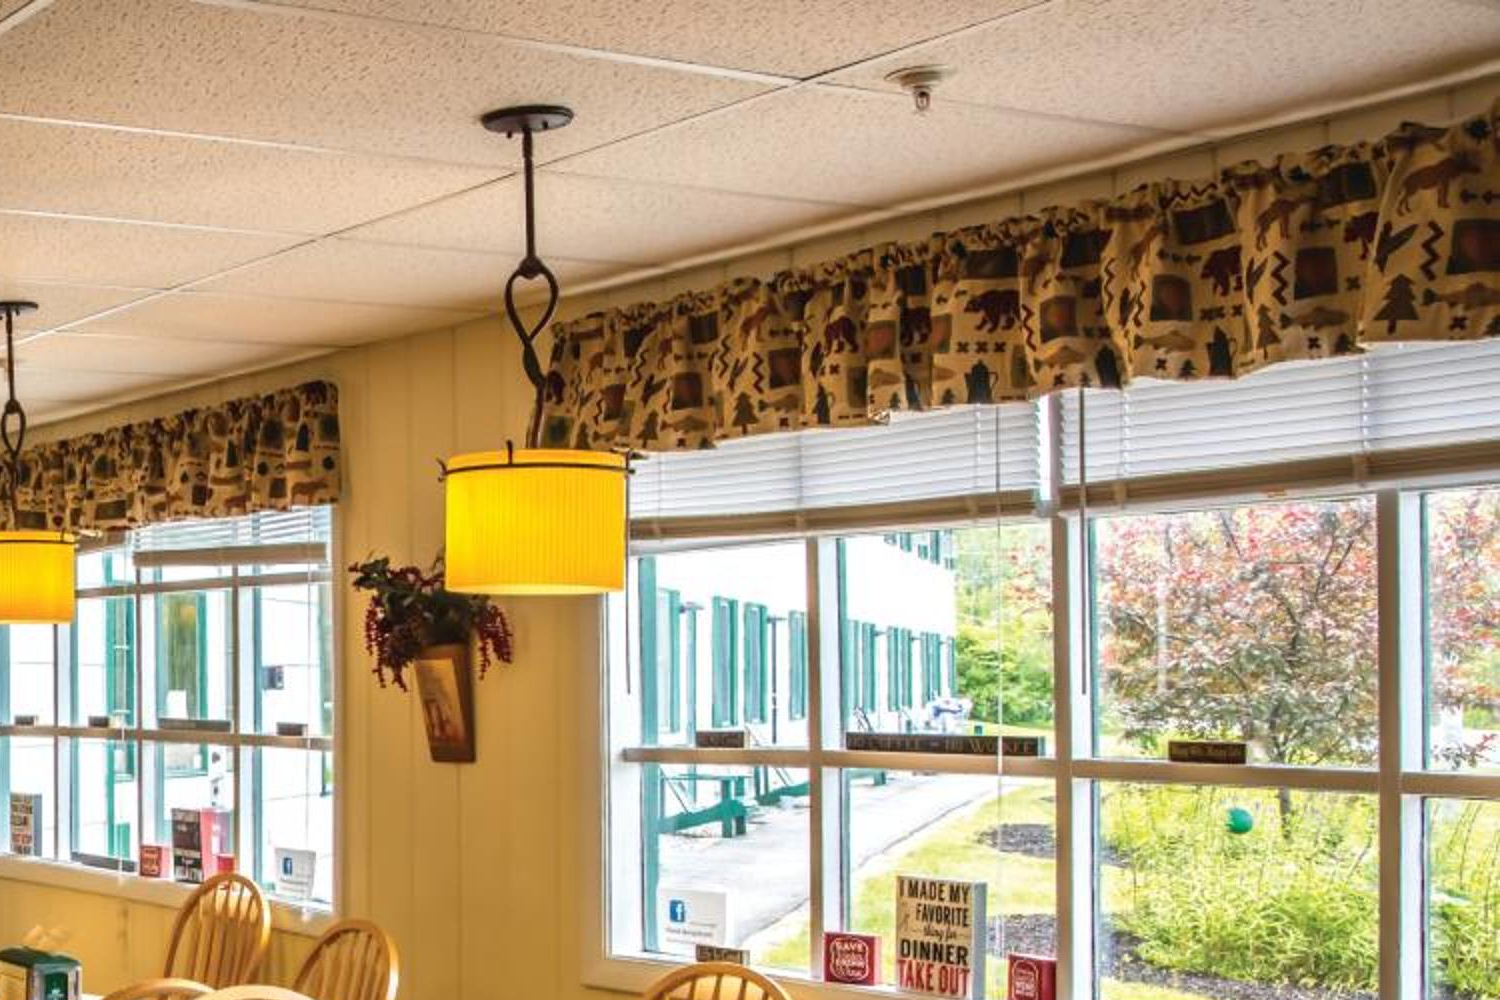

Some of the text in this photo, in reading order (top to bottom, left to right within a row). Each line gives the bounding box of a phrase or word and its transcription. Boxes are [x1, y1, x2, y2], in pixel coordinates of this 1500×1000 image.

[908, 879, 945, 901] MADE
[949, 882, 971, 904] MY
[916, 903, 970, 928] FAVORITE
[900, 939, 969, 966] DINNER
[898, 959, 970, 998] TAKE OUT
